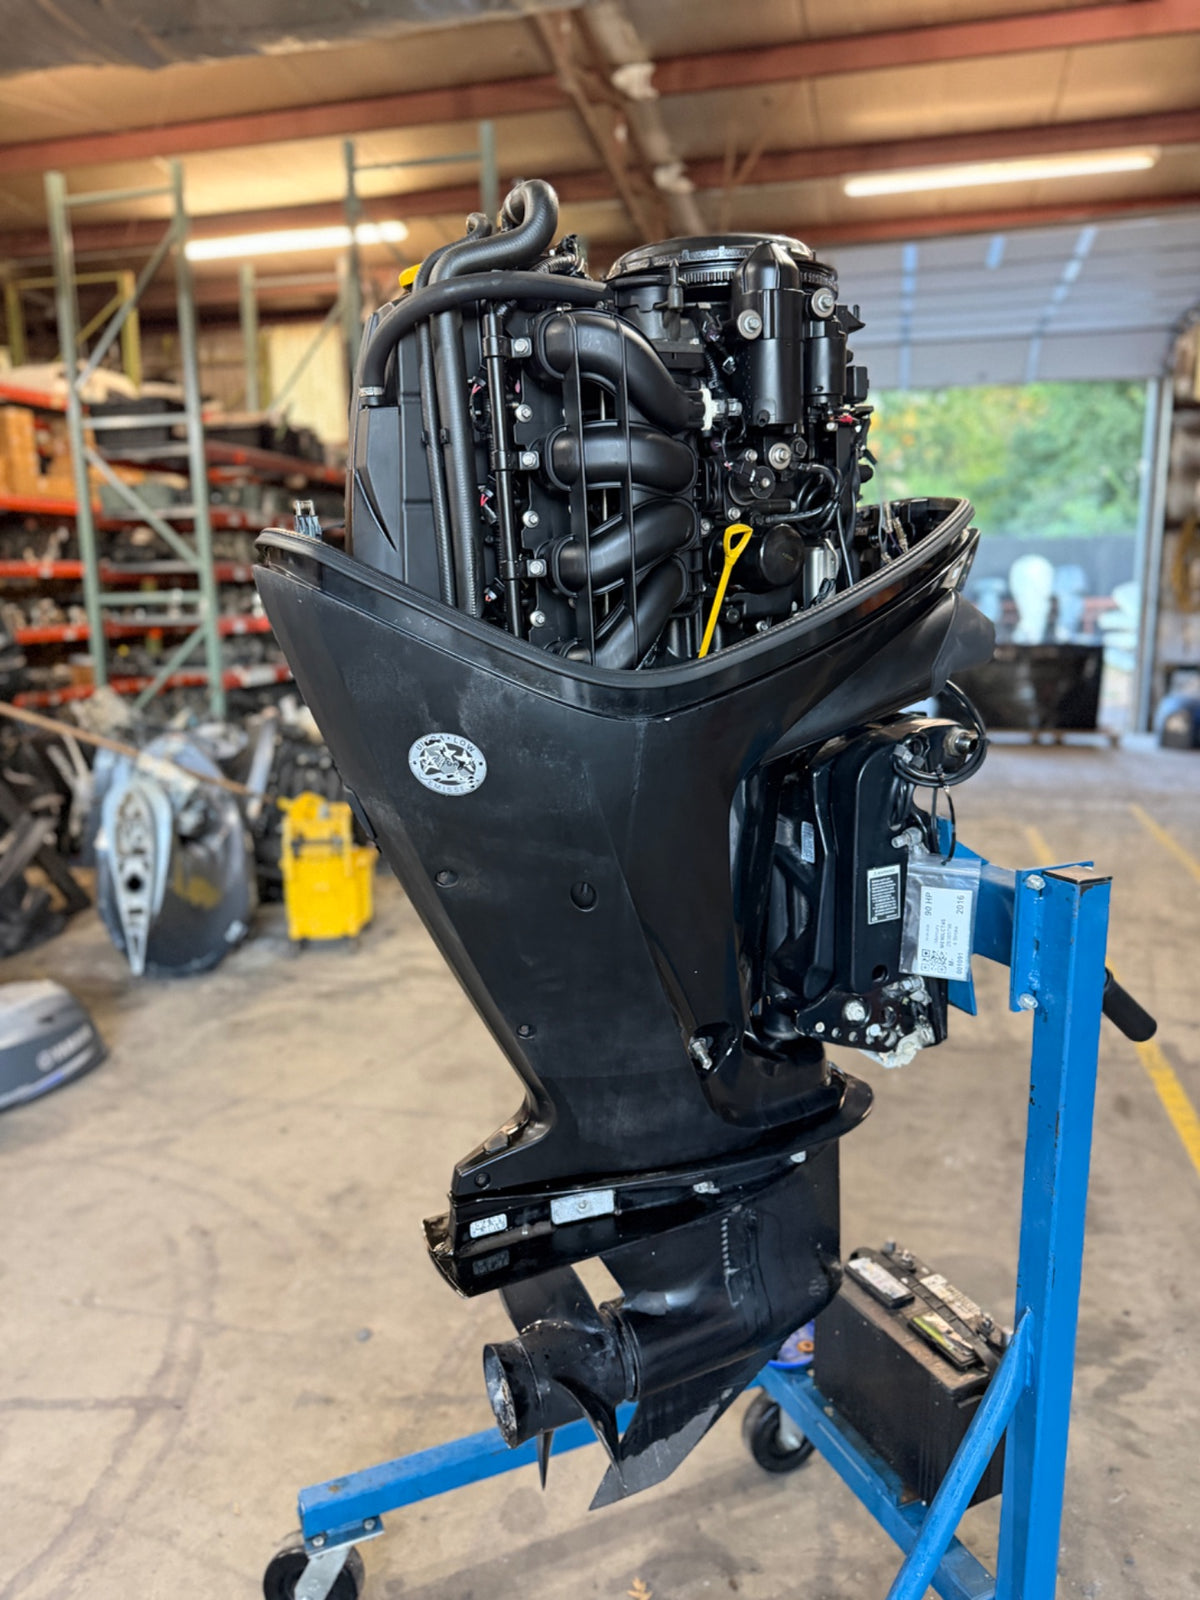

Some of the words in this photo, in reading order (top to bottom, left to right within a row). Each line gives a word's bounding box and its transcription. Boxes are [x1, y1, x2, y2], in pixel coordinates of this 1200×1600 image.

[453, 736, 476, 753] LOW
[924, 892, 933, 904] HP
[956, 895, 965, 915] 2016
[924, 906, 933, 916] 90
